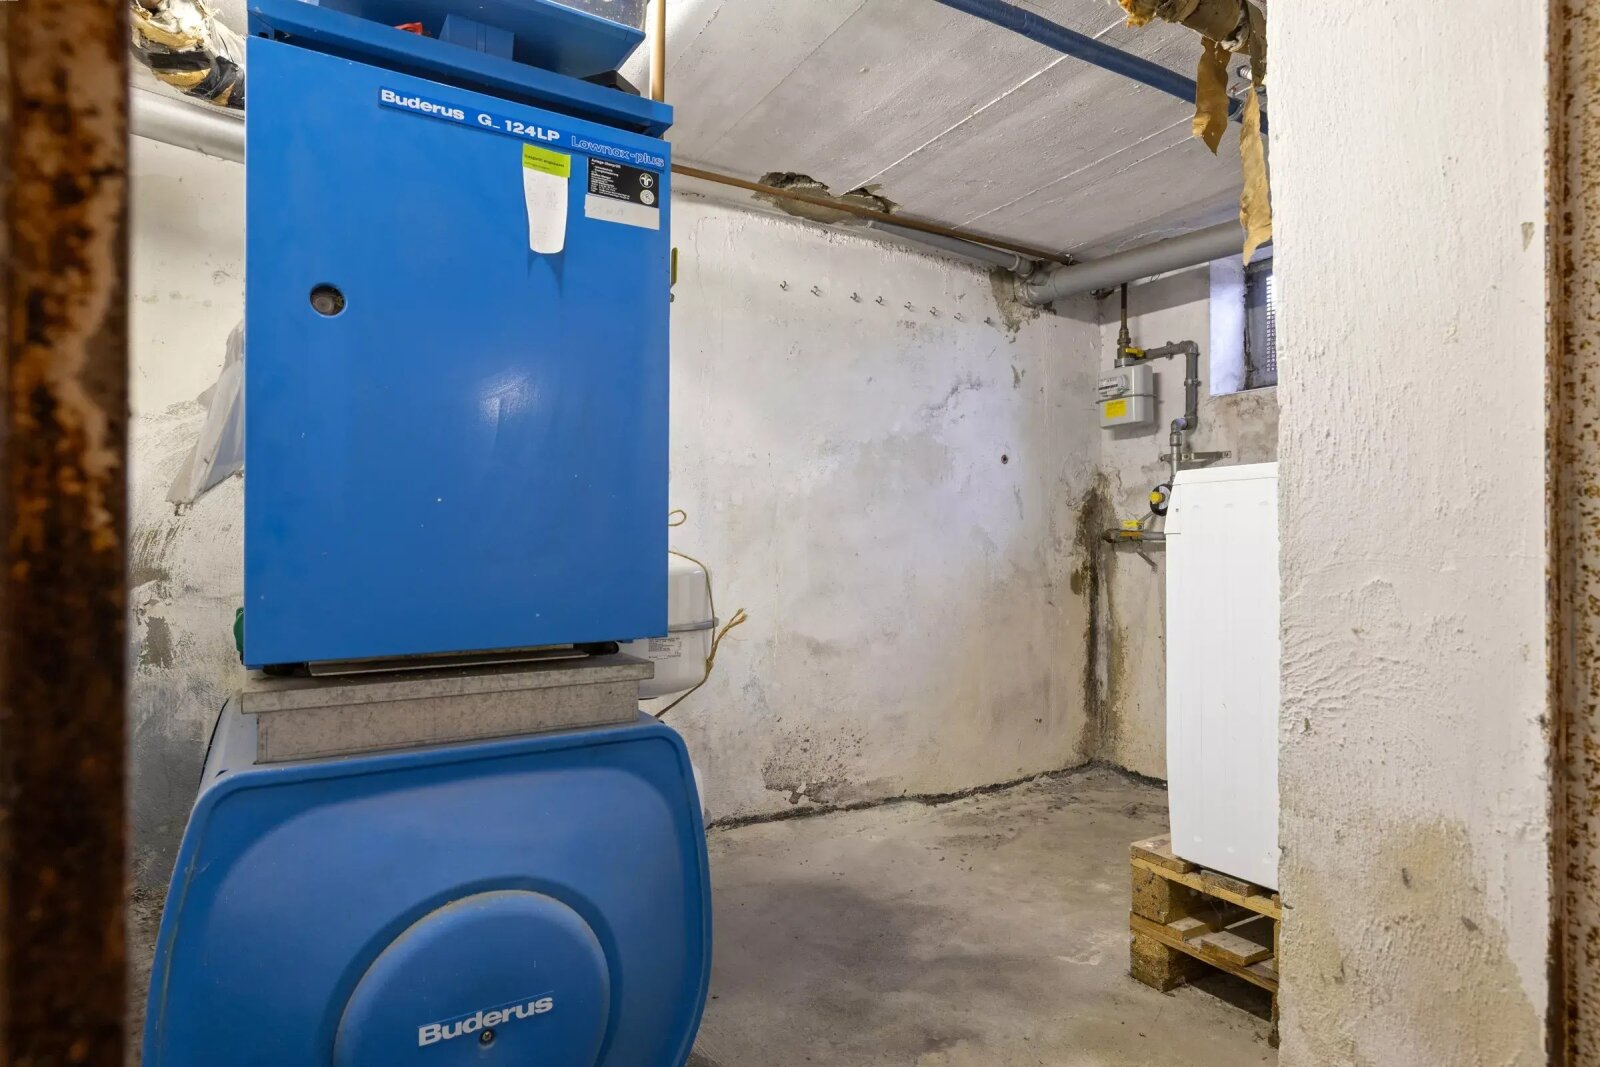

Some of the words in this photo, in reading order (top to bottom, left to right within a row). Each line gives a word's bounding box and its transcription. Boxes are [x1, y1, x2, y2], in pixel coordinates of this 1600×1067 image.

[381, 89, 465, 121] Buderus
[504, 119, 560, 141] 124LP
[571, 135, 665, 168] Lownox-plus
[418, 997, 554, 1047] Buderus
